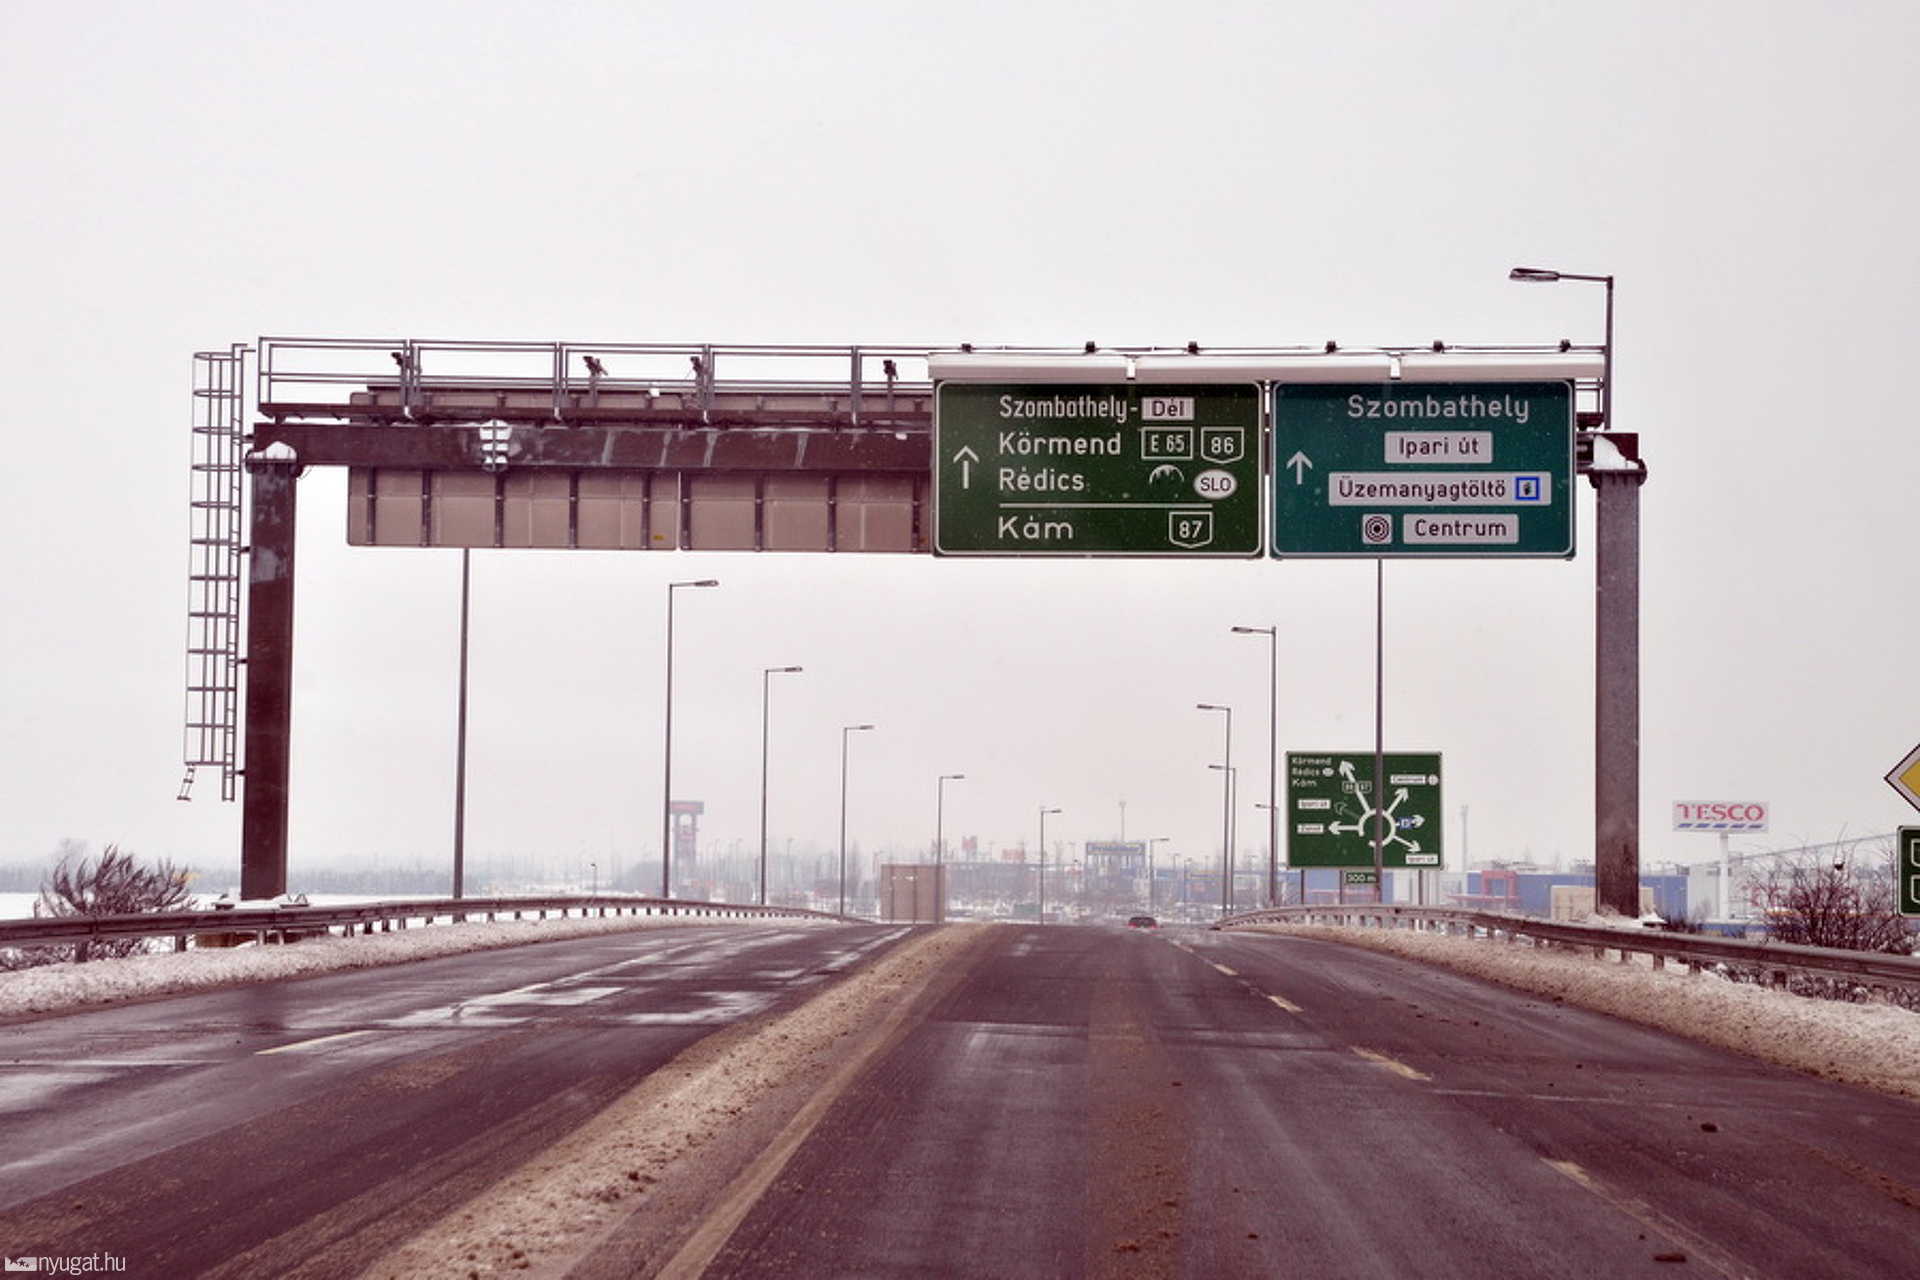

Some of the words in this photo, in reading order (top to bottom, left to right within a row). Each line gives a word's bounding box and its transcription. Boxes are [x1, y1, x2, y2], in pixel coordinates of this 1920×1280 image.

[1152, 397, 1184, 417] Dél
[1347, 394, 1529, 424] Szombathely
[1000, 432, 1121, 455] Körmend
[1151, 434, 1160, 452] E
[1166, 434, 1185, 452] 65
[1211, 436, 1234, 454] 86
[1399, 436, 1449, 458] Ipari
[1459, 436, 1479, 455] út
[1000, 466, 1085, 491] Rédics
[1200, 476, 1232, 494] SLO
[998, 515, 1074, 539] Kám
[1179, 520, 1202, 538] 87
[1415, 519, 1507, 537] Centrum
[1677, 803, 1764, 821] TESCO
